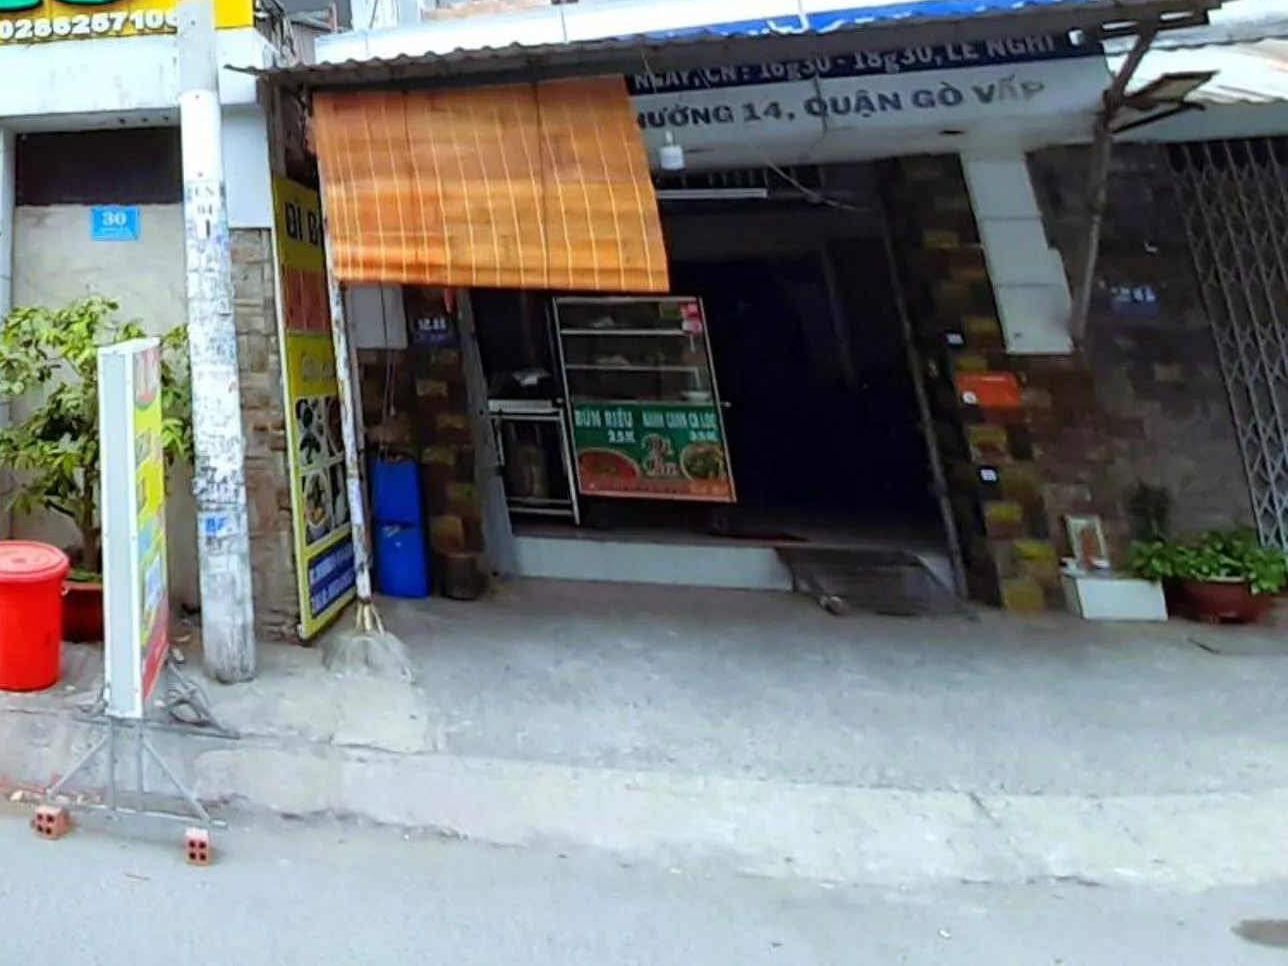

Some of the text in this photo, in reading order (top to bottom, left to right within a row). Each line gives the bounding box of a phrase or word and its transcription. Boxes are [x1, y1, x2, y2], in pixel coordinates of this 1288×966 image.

[742, 101, 795, 123] 14,
[804, 90, 902, 118] QUẬN
[911, 81, 964, 107] GÒ
[103, 210, 127, 227] 30
